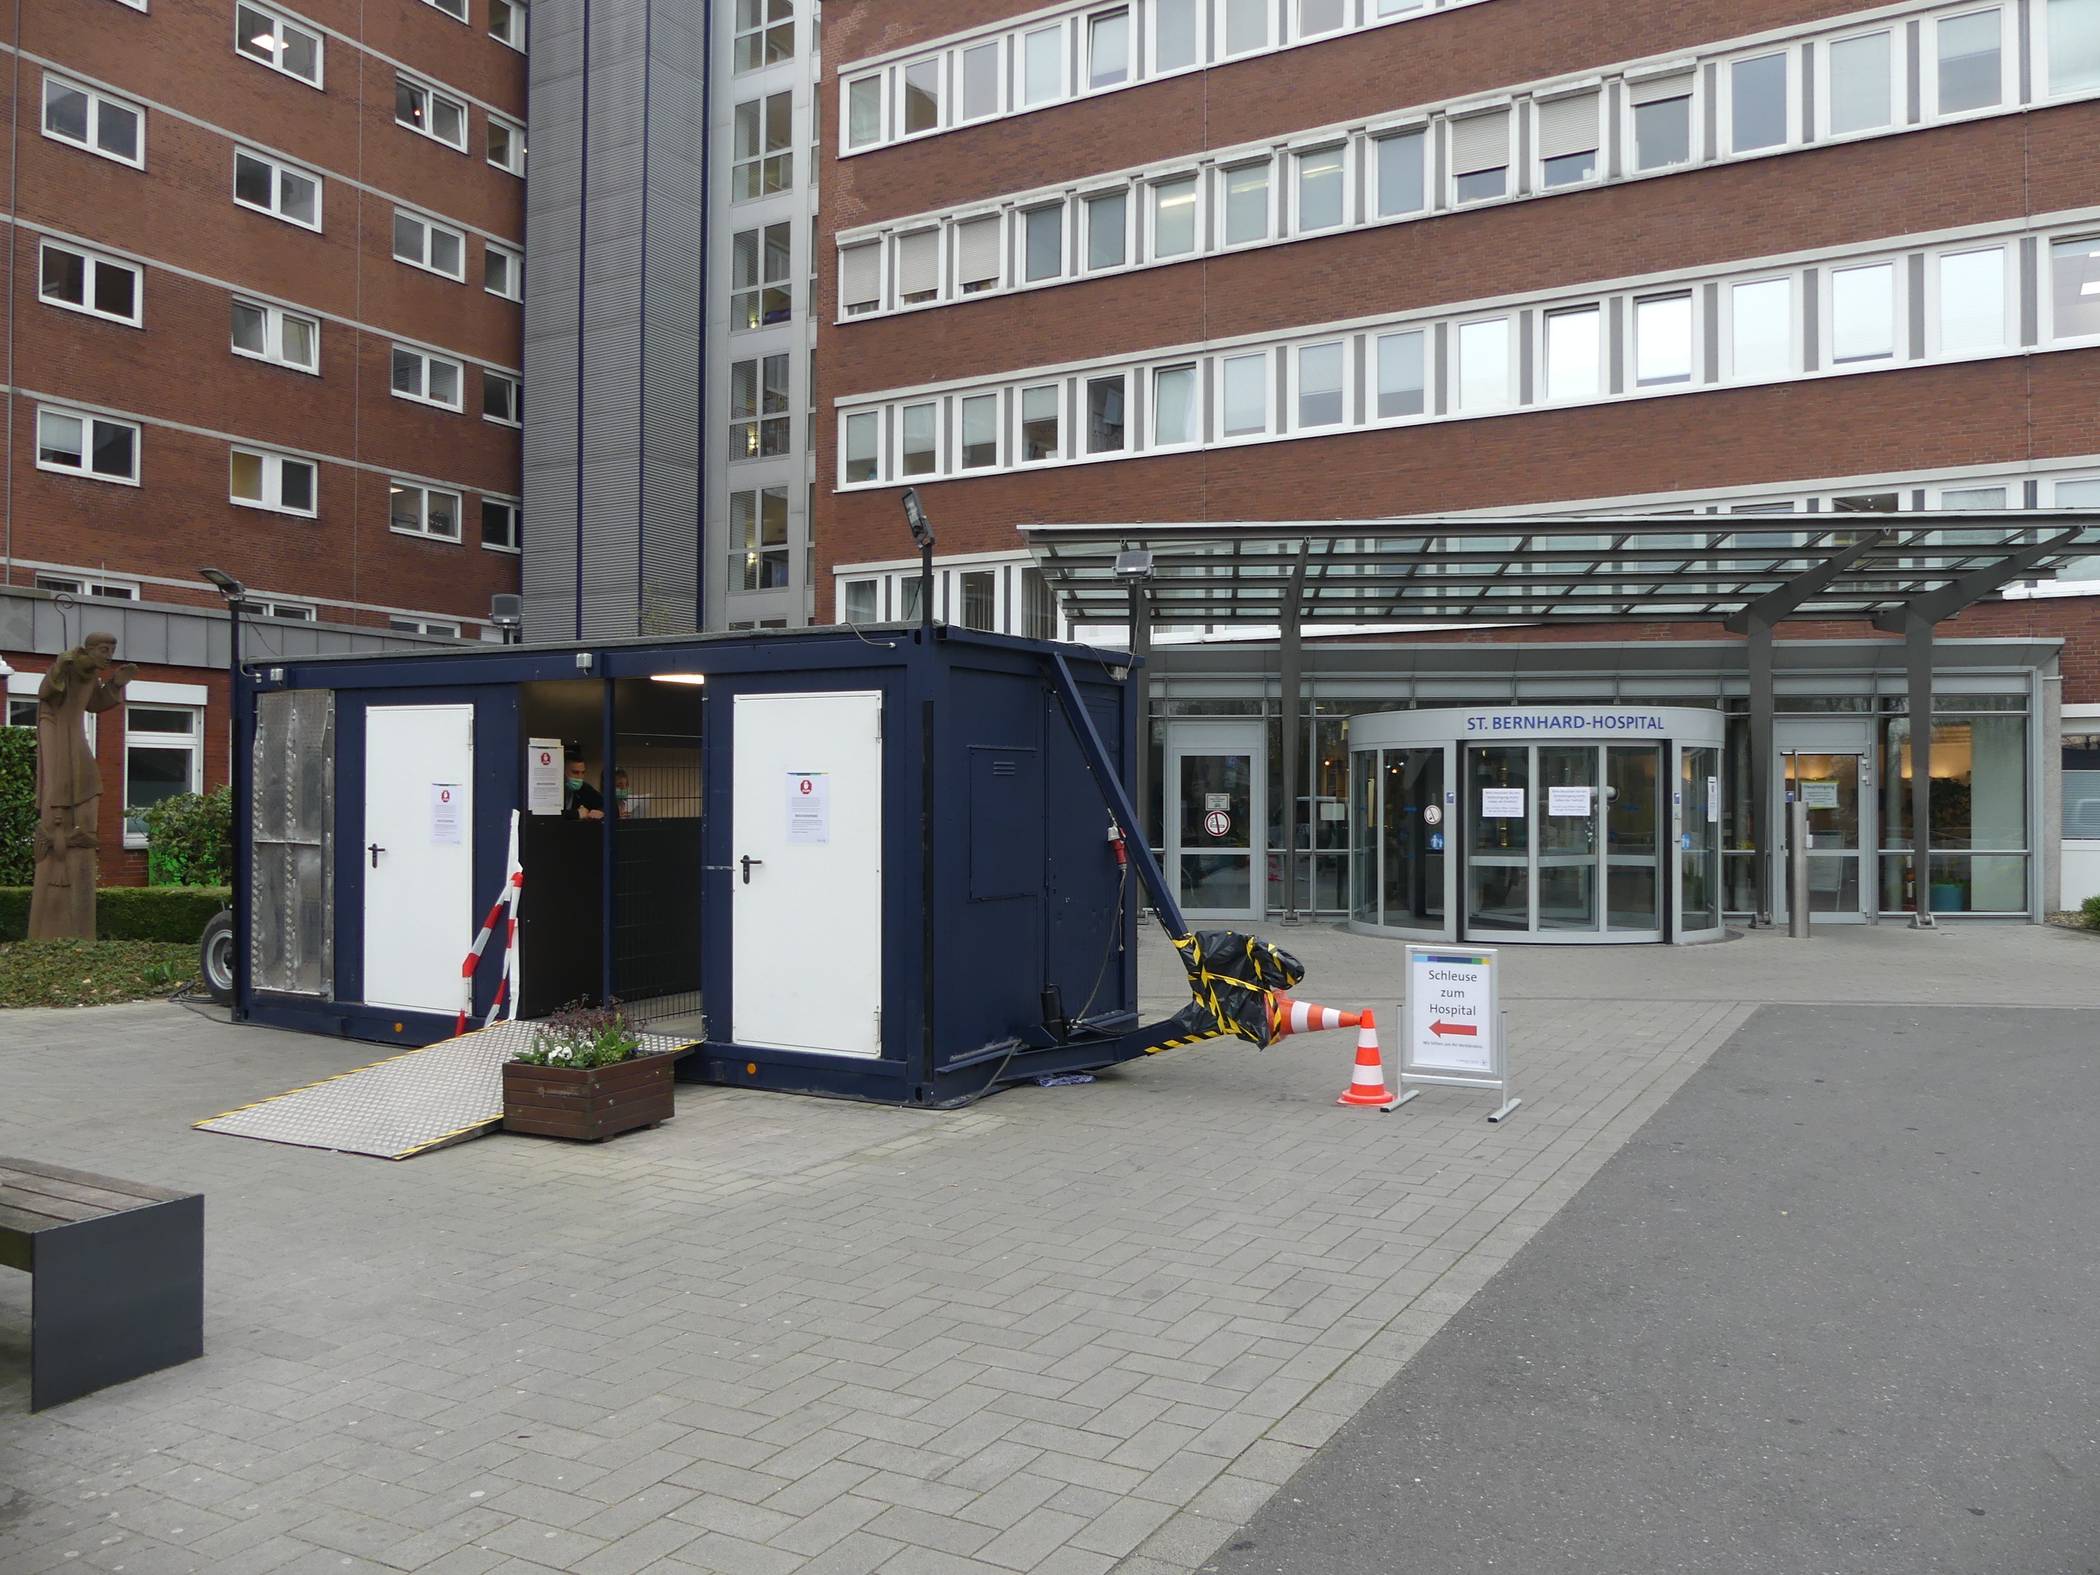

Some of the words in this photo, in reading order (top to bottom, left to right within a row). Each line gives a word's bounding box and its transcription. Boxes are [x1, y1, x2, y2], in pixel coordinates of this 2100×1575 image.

[1467, 717, 1488, 730] ST.
[1492, 715, 1665, 730] BERNHARD-HOSPITAL
[1429, 970, 1477, 982] Schleuse
[1440, 989, 1465, 998] zum
[1429, 1003, 1476, 1017] Hospital
